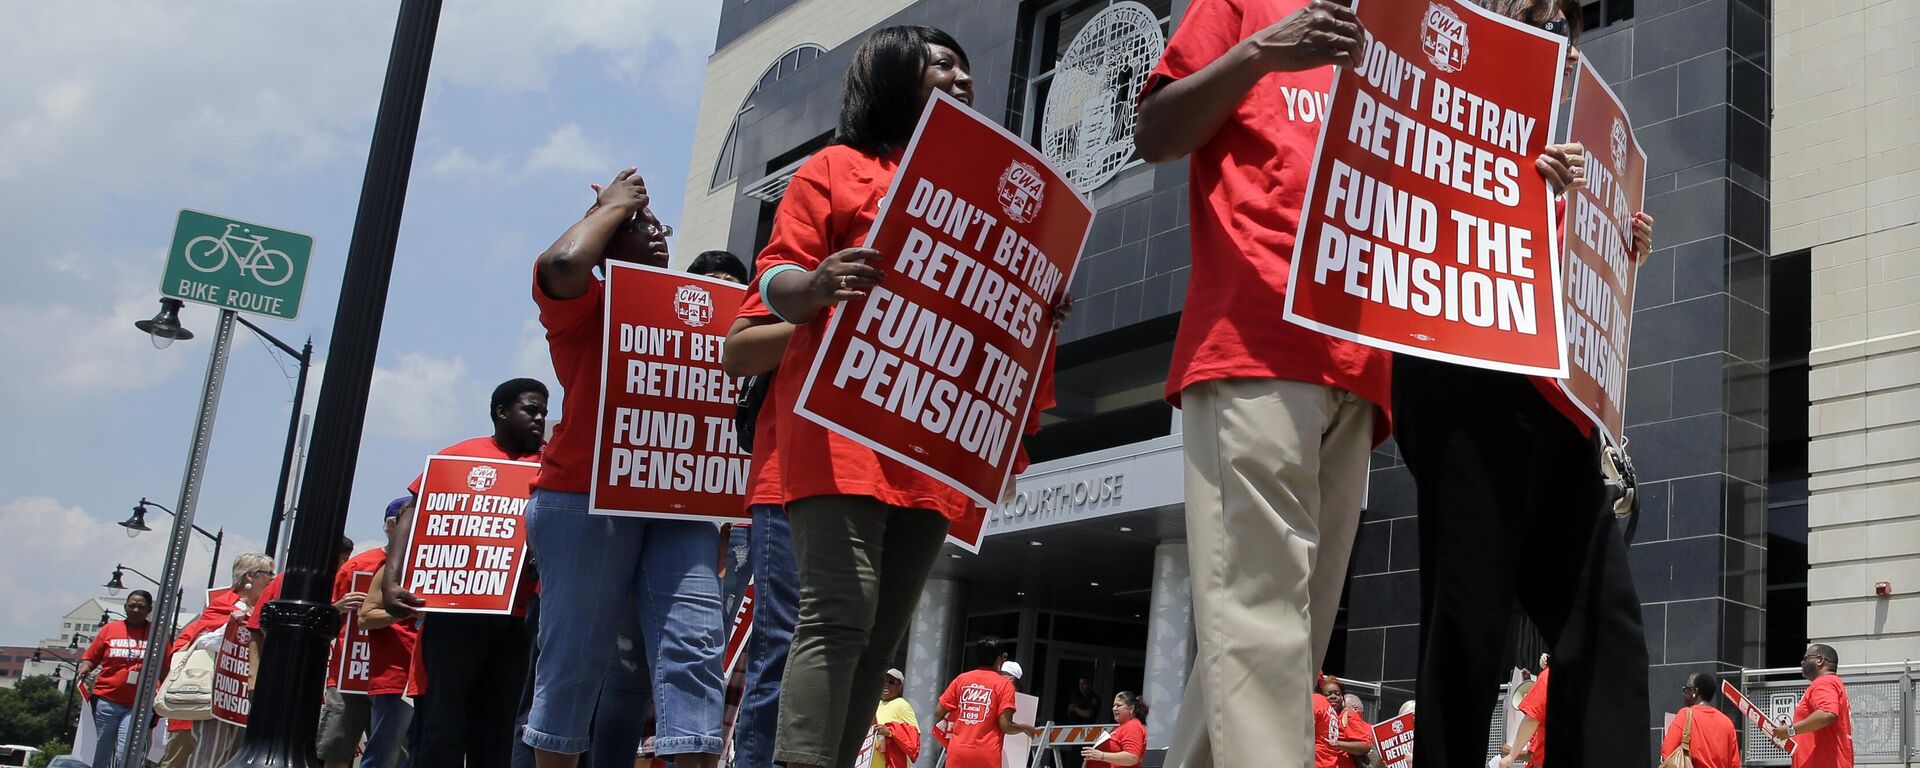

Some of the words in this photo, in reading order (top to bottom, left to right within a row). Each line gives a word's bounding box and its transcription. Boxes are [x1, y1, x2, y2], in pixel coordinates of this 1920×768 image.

[1115, 11, 1141, 24] STATE
[1430, 10, 1462, 40] CWA
[1431, 78, 1536, 157] BETRAY
[1348, 88, 1520, 207] RETIREES
[1010, 168, 1042, 196] CWA
[1584, 150, 1613, 208] ON'T
[1324, 158, 1438, 254] FUND
[1451, 208, 1536, 279] THE
[905, 177, 997, 253] DON'T
[993, 229, 1063, 304] BETRAY
[893, 228, 1042, 349] RETIREES
[1314, 222, 1538, 335] PENSION
[1567, 249, 1611, 332] FUND
[178, 279, 220, 302] BIKE
[226, 289, 284, 314] ROUTE
[679, 289, 708, 305] CWA
[620, 323, 684, 359] DON'T
[690, 332, 726, 363] BET
[855, 287, 975, 379] FUND
[974, 343, 1028, 417] THE
[1566, 302, 1623, 414] PENSION
[832, 336, 1012, 469] PENSION
[613, 406, 695, 450] FUND
[704, 416, 752, 456] TH
[609, 448, 751, 496] PENSION
[425, 492, 470, 512] DON'T
[471, 494, 530, 516] BETRAY
[1003, 473, 1124, 519] COURTHOUSE
[426, 514, 517, 539] RETIREES
[414, 544, 471, 569] FUND
[475, 545, 515, 570] THE
[410, 569, 509, 596] PENSION
[220, 654, 250, 677] RETIRE
[352, 641, 371, 660] FU
[215, 673, 239, 694] FUND
[963, 688, 989, 703] CWA
[213, 690, 250, 715] PENSIO
[963, 704, 981, 712] Local
[1775, 698, 1792, 706] KEEP
[1381, 736, 1398, 751] DON'T
[1399, 730, 1414, 743] BETR
